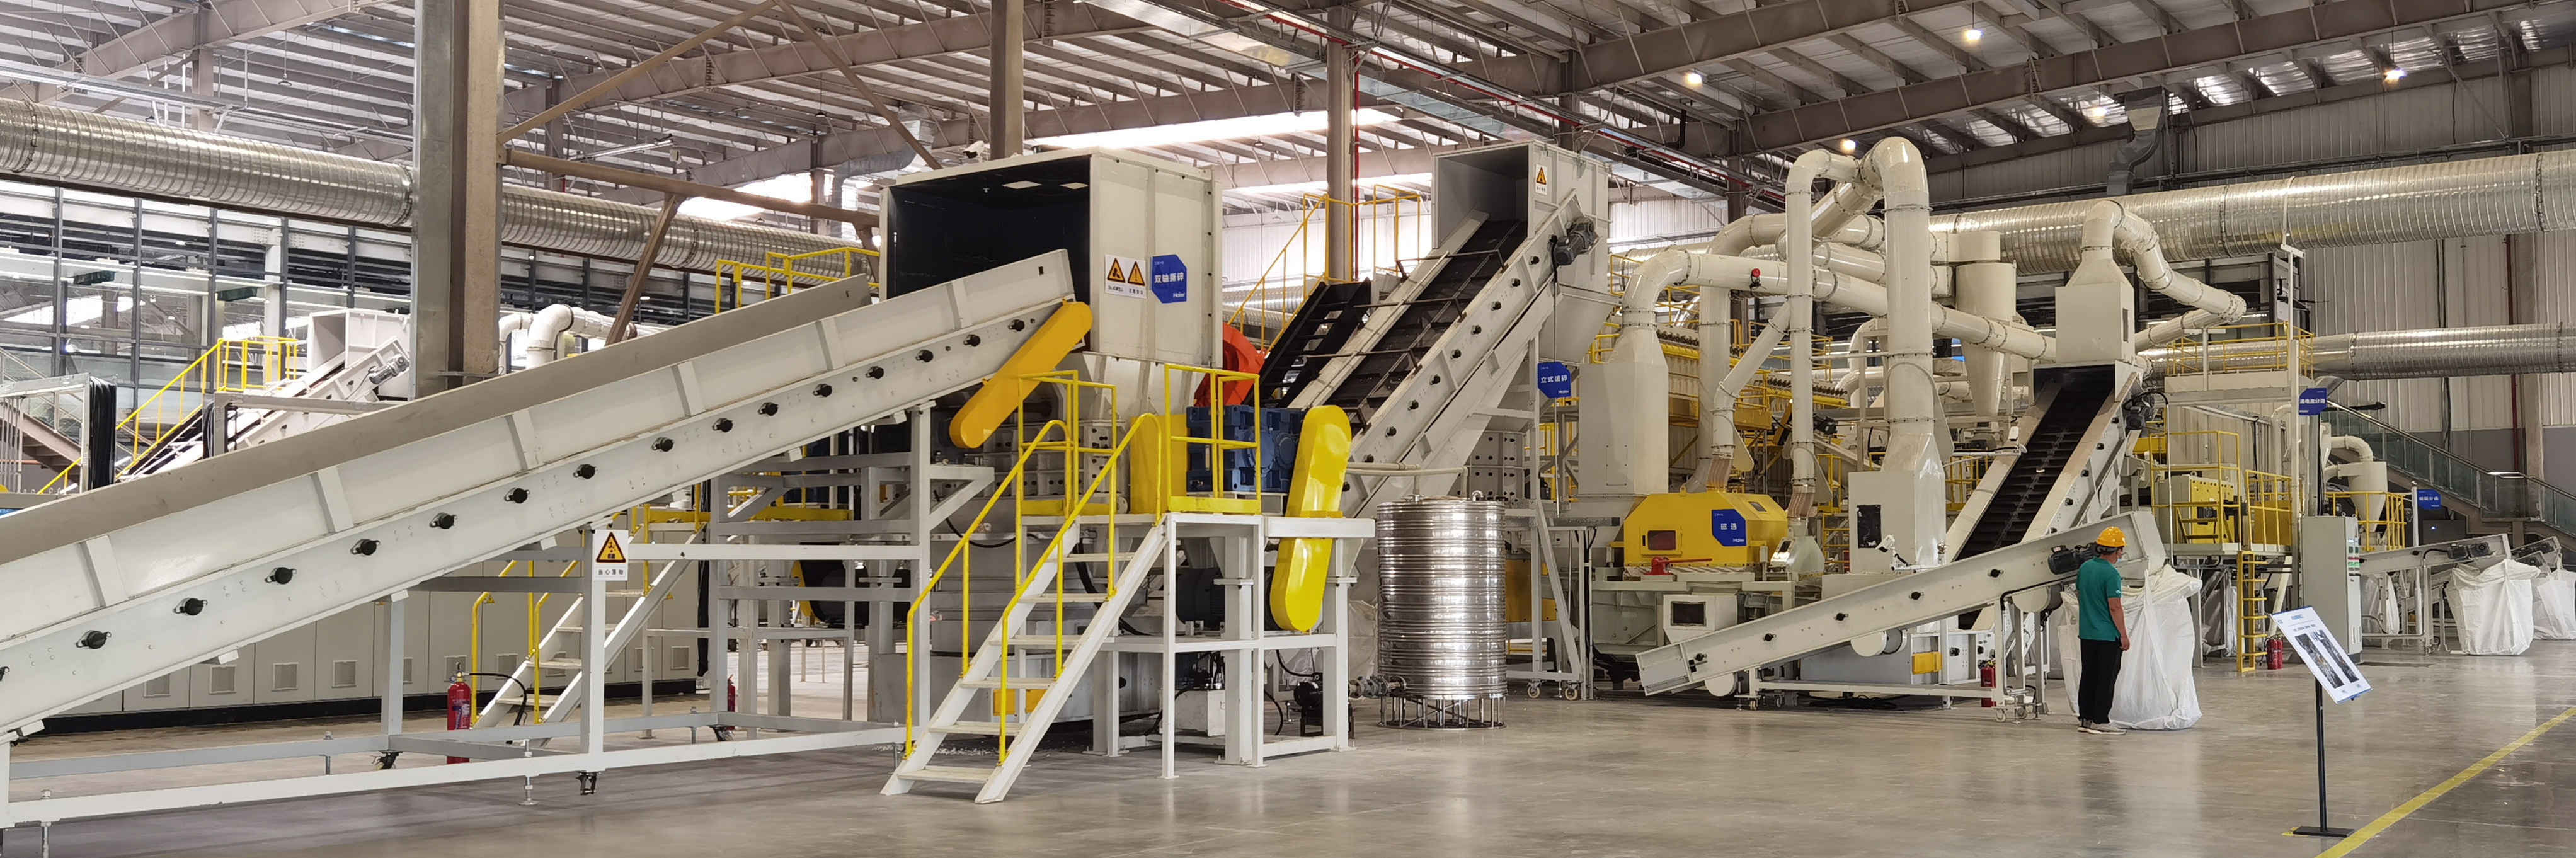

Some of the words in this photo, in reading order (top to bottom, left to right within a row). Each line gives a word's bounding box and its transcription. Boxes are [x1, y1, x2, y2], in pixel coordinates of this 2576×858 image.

[1154, 272, 1184, 283] 双轴撕碎
[1541, 374, 1568, 384] 立式破碎
